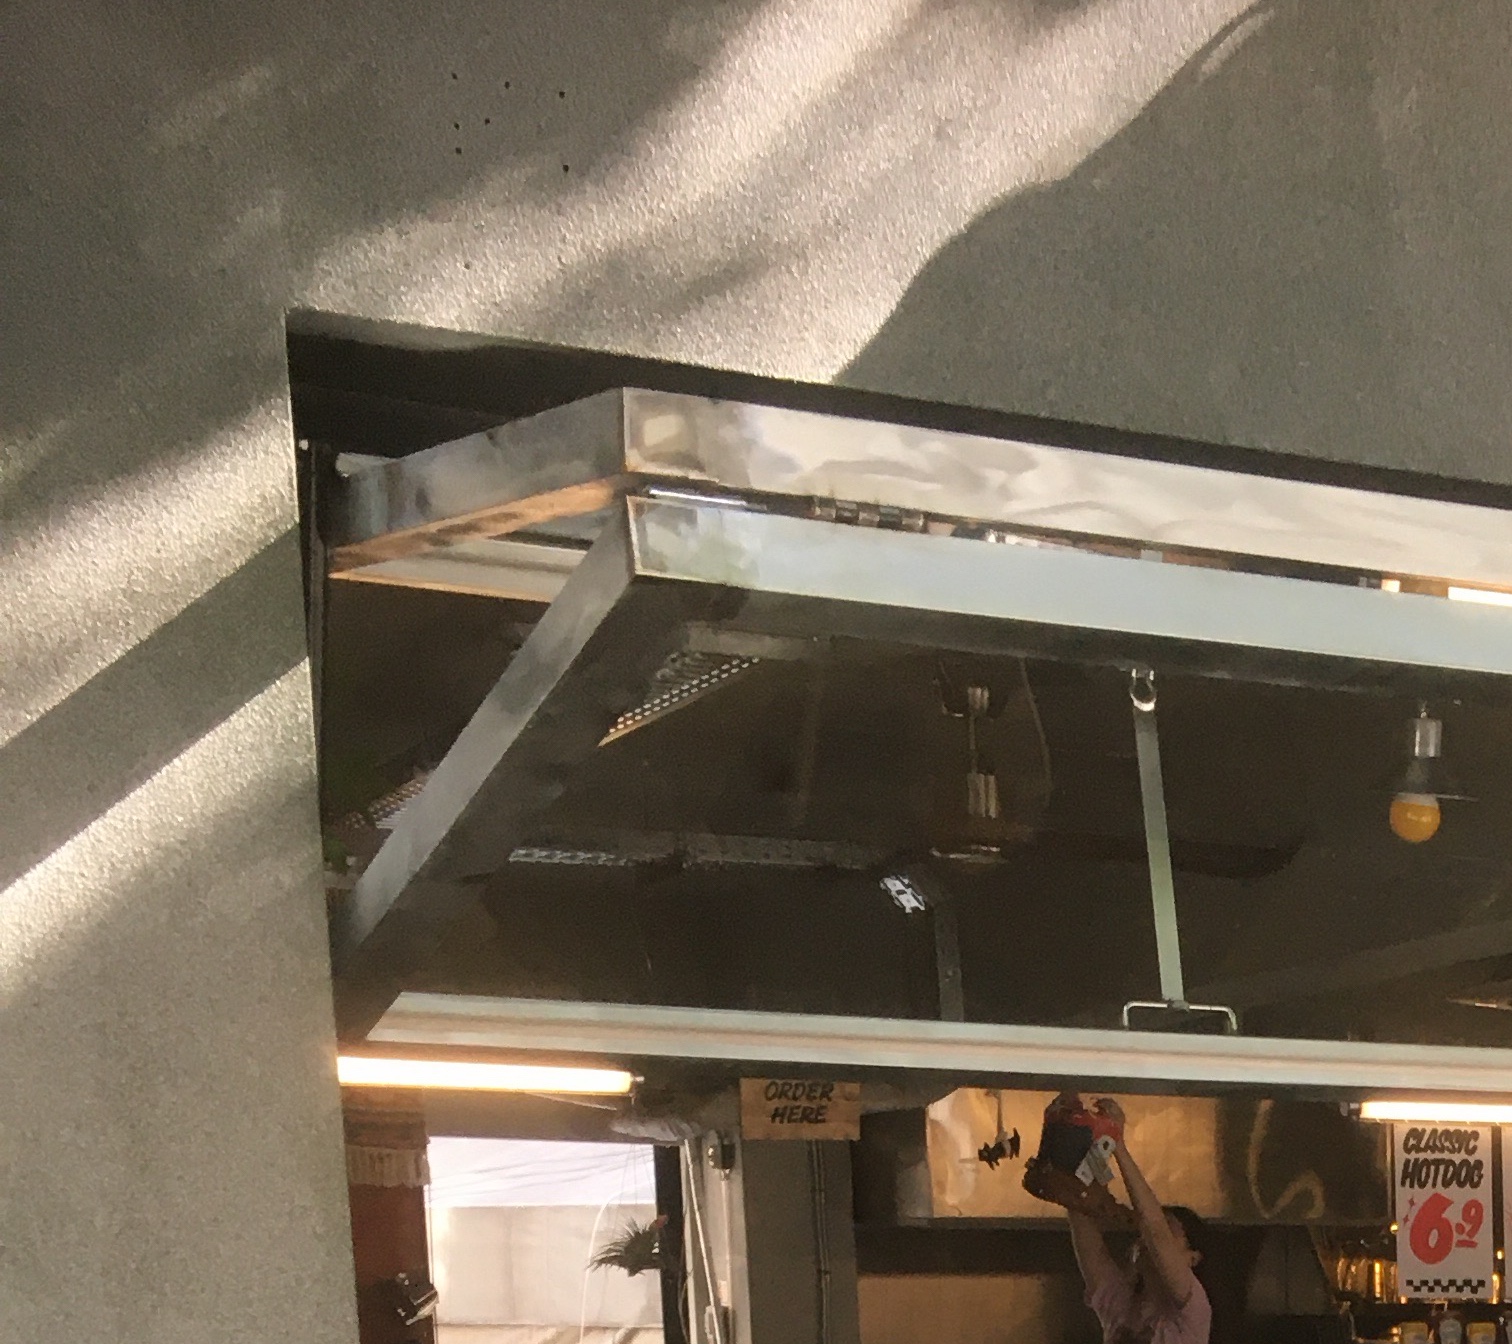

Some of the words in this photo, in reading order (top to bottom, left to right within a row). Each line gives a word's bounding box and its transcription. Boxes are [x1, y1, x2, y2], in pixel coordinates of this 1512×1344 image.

[764, 1081, 834, 1101] ORDER
[770, 1105, 828, 1124] HERE
[1402, 1127, 1480, 1156] CLASSIC
[1400, 1158, 1484, 1189] HOTDOG
